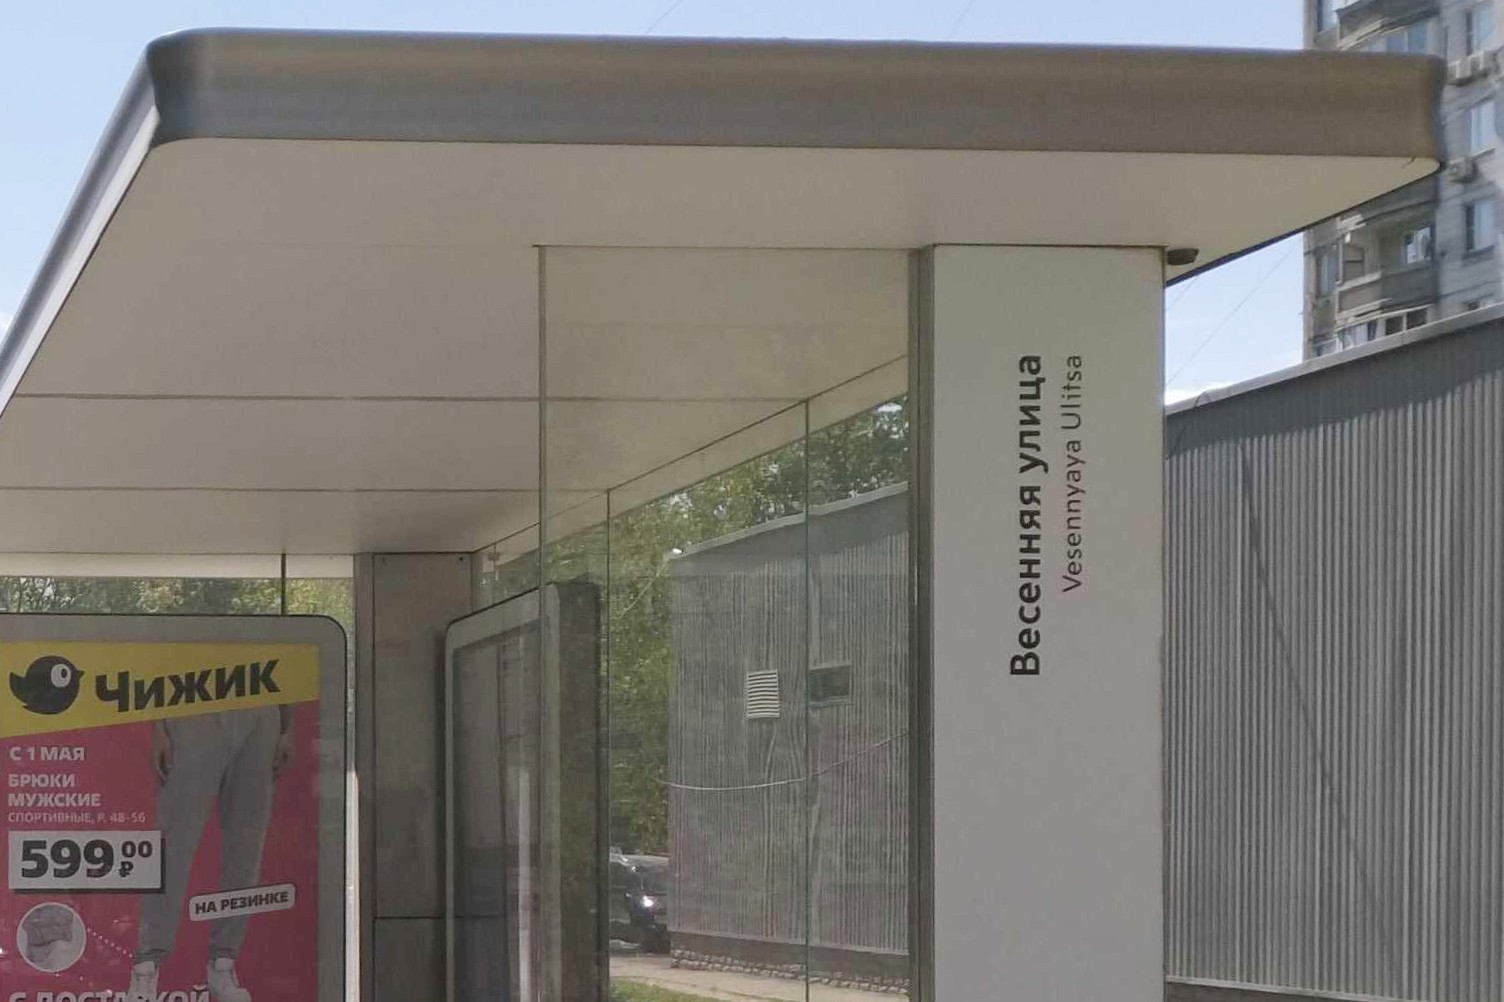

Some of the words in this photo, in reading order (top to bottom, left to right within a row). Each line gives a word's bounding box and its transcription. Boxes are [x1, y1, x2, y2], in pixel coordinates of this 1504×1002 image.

[1060, 354, 1082, 430] Ulitsa
[1018, 355, 1049, 474] улица
[1062, 439, 1086, 593] Vesennyaya
[1009, 485, 1042, 676] Весенняя
[9, 746, 22, 761] С
[27, 746, 36, 761] 1
[40, 746, 86, 761] МАЯ
[8, 773, 76, 788] БРЮКИ
[7, 793, 102, 807] МУЖСКИЕ
[109, 812, 147, 823] 48-56
[21, 839, 114, 879] 599
[195, 901, 217, 914] НА
[221, 891, 289, 911] РЕЗИНКЕ
